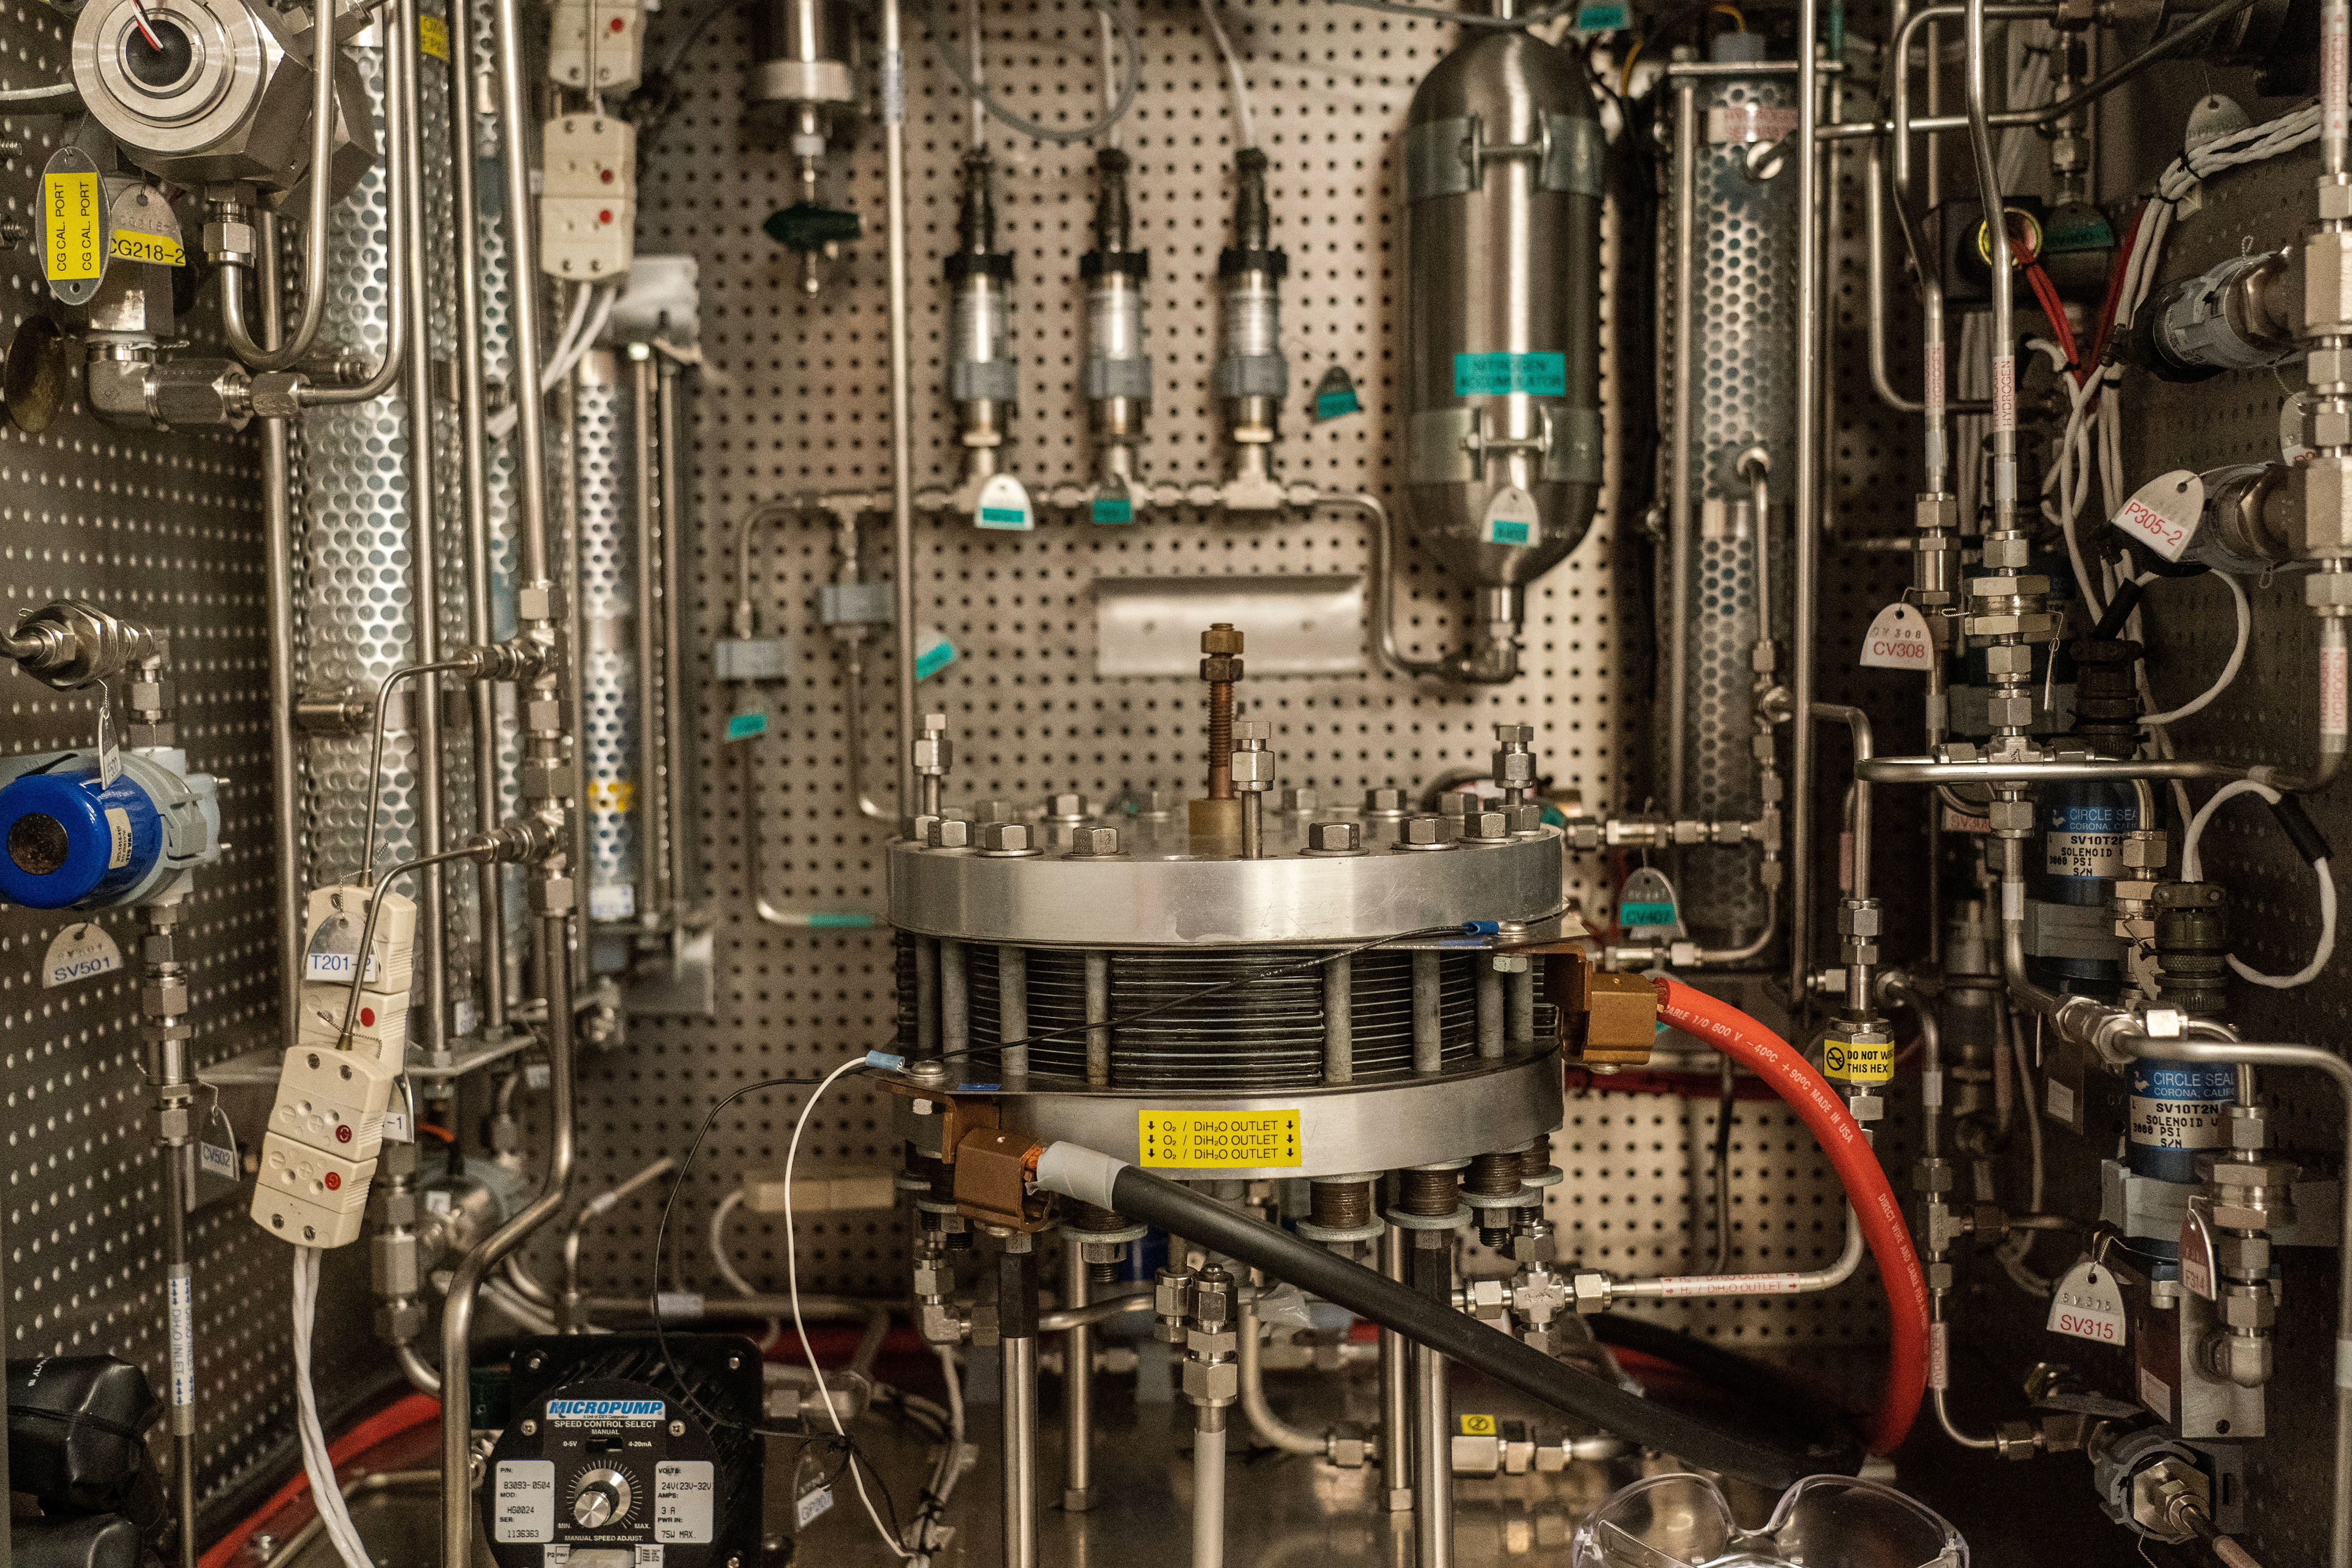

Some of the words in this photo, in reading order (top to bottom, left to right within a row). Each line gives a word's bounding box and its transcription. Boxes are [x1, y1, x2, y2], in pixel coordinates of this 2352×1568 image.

[55, 182, 65, 216] PORT
[80, 182, 90, 216] PORT
[56, 222, 66, 249] CAL.
[82, 222, 91, 248] CAL.
[57, 253, 66, 271] CG
[83, 253, 91, 270] CG
[2001, 360, 2012, 426] HYDROGEN
[2125, 501, 2183, 547] P305-2
[1873, 641, 1924, 659] CV308
[2070, 809, 2112, 821] CIRCLE
[2061, 847, 2112, 857] SOLENOID
[2073, 857, 2092, 867] PSI
[2073, 868, 2093, 877] S/N
[55, 957, 110, 981] SV501
[1847, 1051, 1859, 1060] DO
[1861, 1051, 1878, 1060] NOT
[1847, 1064, 1867, 1073] THIS
[1870, 1064, 1888, 1073] HEX
[1711, 1022, 1732, 1037] 600
[1734, 1032, 1743, 1042] V
[1810, 1088, 1832, 1113] MADE
[1830, 1111, 1841, 1124] IN
[1838, 1123, 1854, 1144] USA
[2153, 1072, 2201, 1087] CIRCLE
[1231, 1121, 1278, 1132] OUTLET
[2146, 1114, 2203, 1127] SOLENOID
[2160, 1126, 2181, 1137] PSI
[1231, 1134, 1278, 1145] OUTLET
[2161, 1138, 2182, 1149] S/N
[1231, 1148, 1278, 1159] OUTLET
[1878, 1193, 1896, 1222] DIRECT
[1892, 1221, 1904, 1244] WIRE
[1900, 1244, 1911, 1262] AND
[1740, 1281, 1782, 1292] OUTLET
[2060, 1314, 2114, 1340] SV315
[549, 1401, 663, 1414] MICROPUMP
